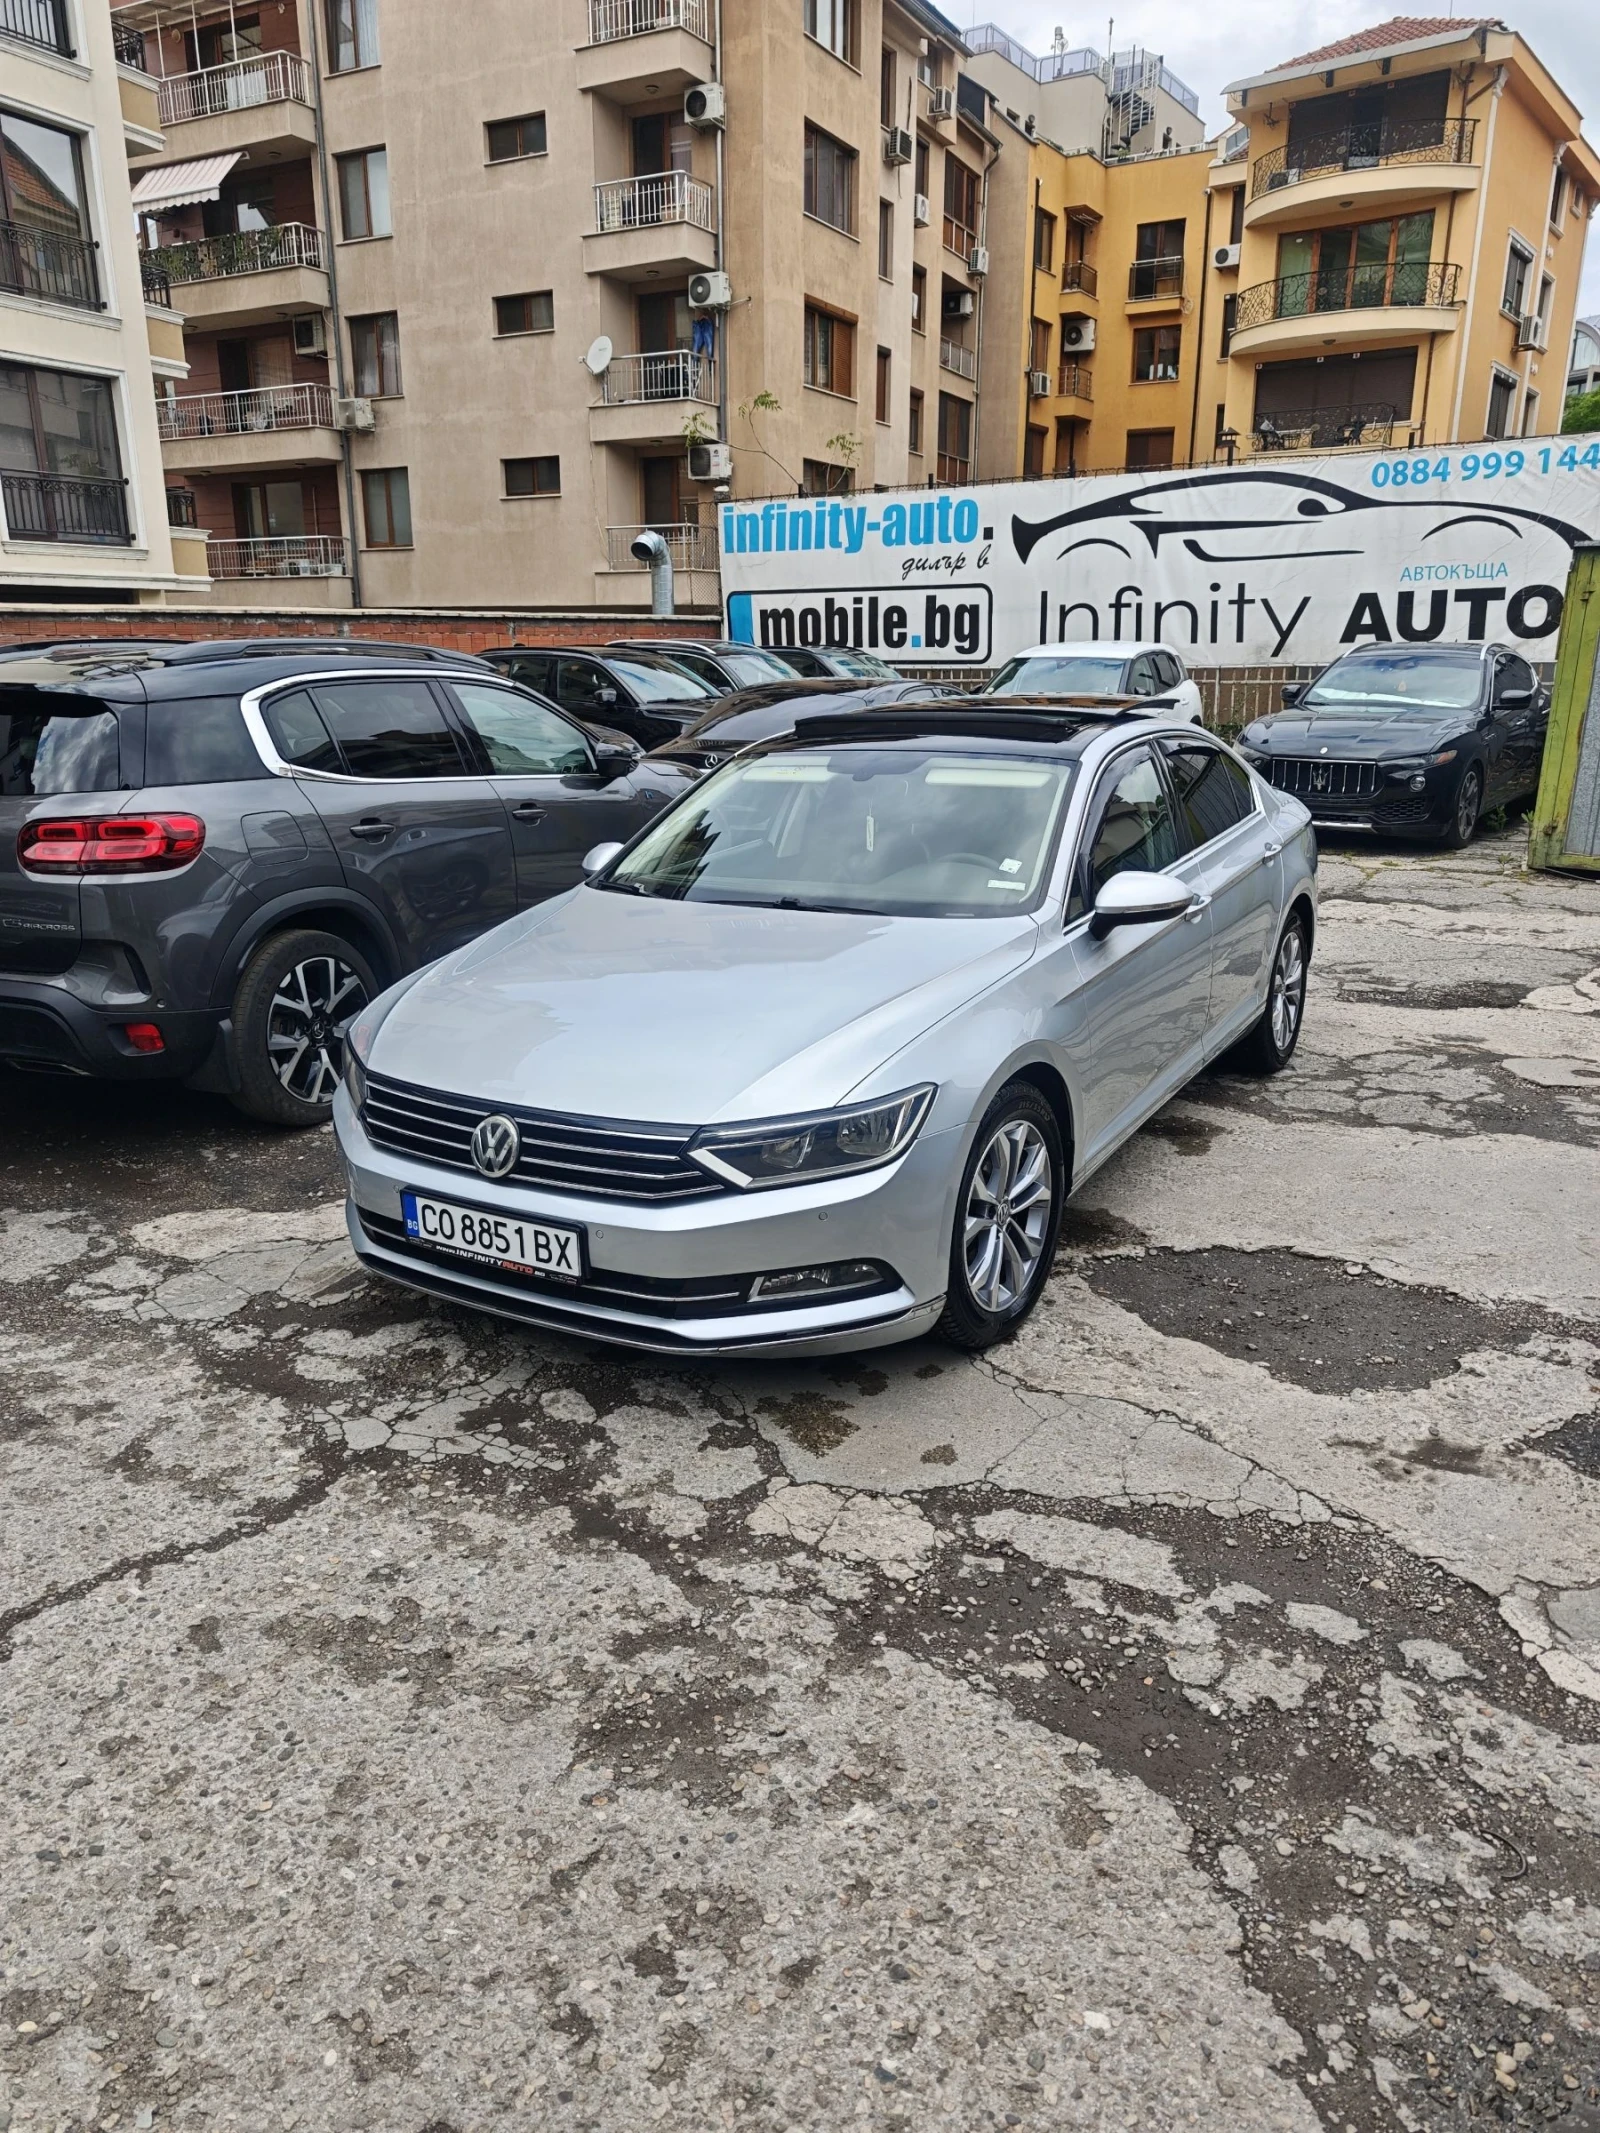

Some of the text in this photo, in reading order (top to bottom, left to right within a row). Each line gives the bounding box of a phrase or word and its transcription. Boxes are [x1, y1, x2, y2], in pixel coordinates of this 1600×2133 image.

[1371, 443, 1600, 488] 0884 999 144
[902, 552, 966, 581] дилър
[1400, 562, 1509, 582] АВТОКЪЩА
[759, 595, 981, 655] mobile.bg
[1039, 582, 1564, 658] Infinity AUTO
[407, 1219, 418, 1231] BG
[461, 1214, 525, 1258] 8851
